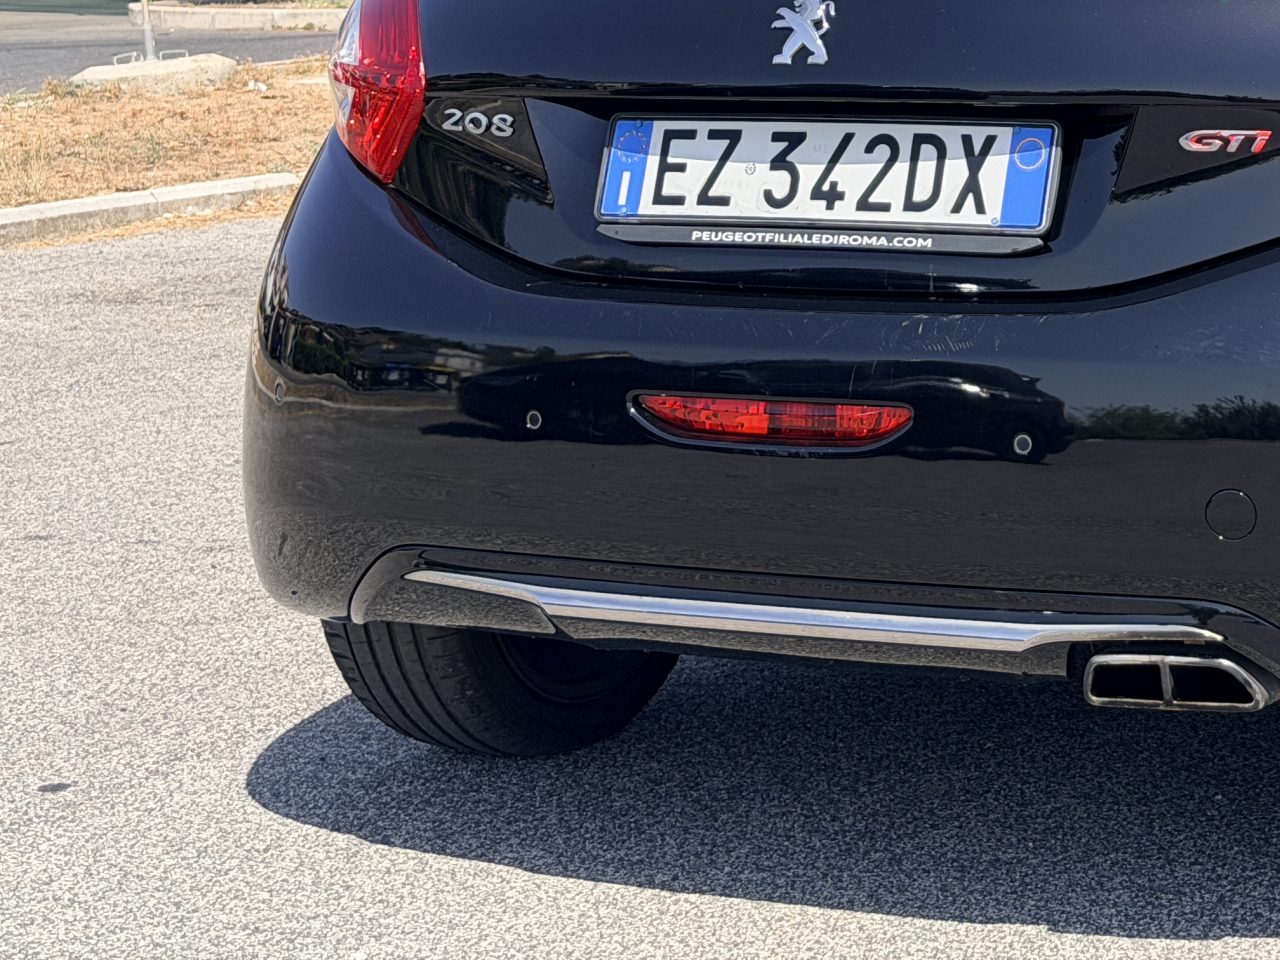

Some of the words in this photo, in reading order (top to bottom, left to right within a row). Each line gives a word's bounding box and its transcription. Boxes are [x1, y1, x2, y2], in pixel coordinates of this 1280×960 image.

[441, 108, 515, 137] 208
[616, 170, 632, 207] I
[651, 128, 743, 208] EZ
[762, 131, 998, 216] 342DX
[691, 229, 933, 249] PEUGEOTFILIALEDIROMA.COM
